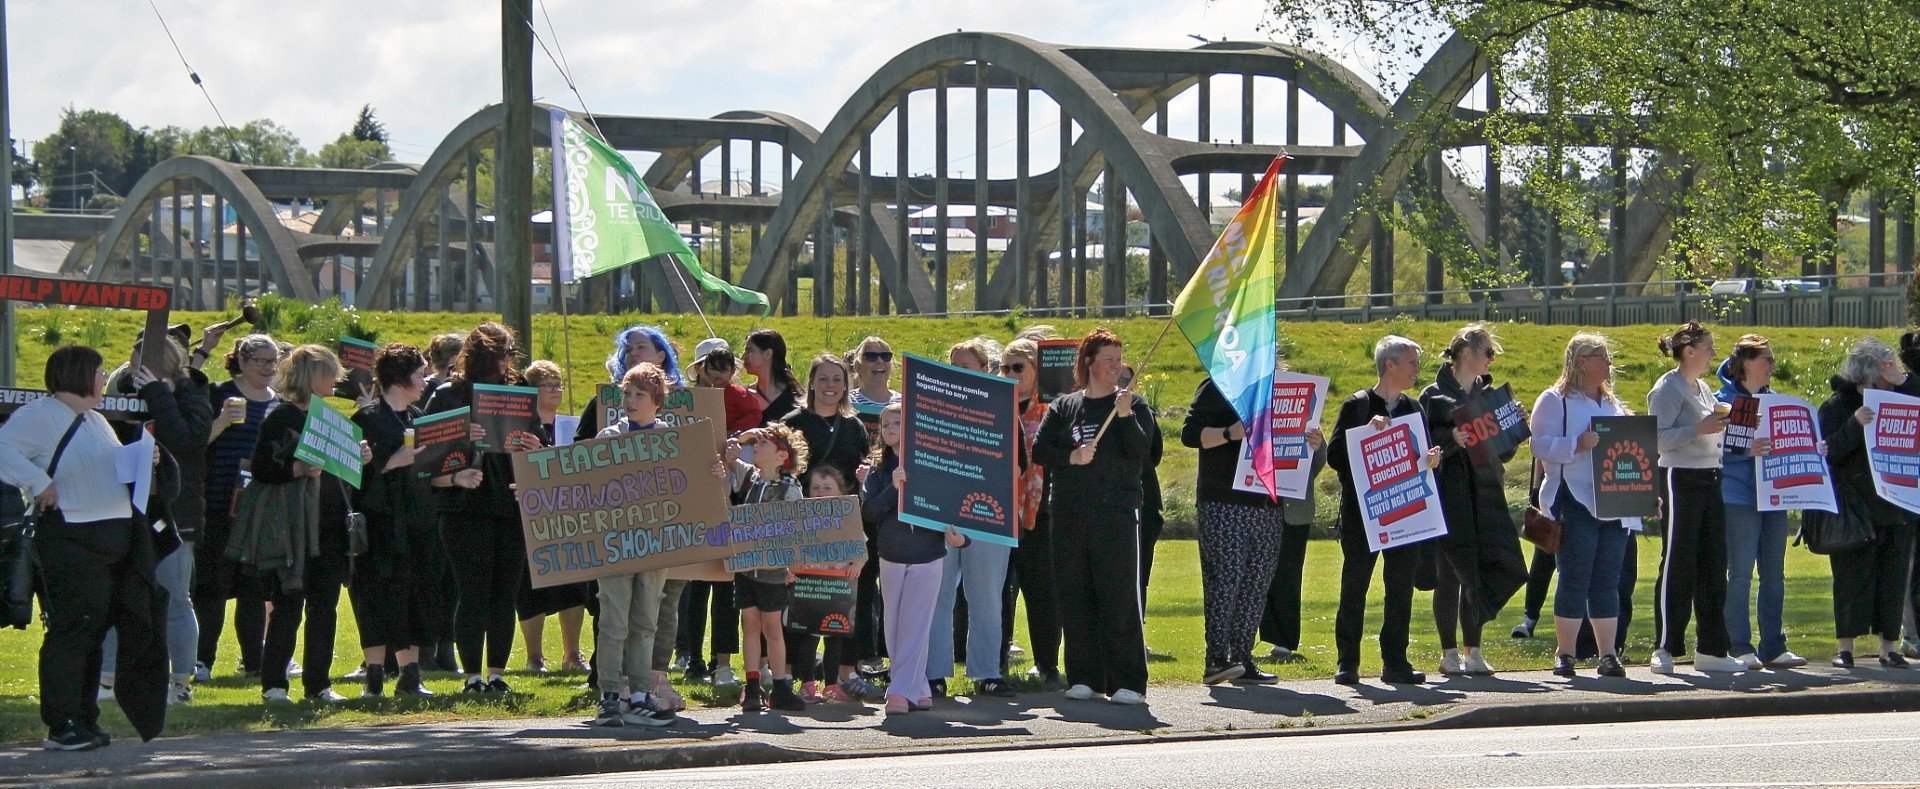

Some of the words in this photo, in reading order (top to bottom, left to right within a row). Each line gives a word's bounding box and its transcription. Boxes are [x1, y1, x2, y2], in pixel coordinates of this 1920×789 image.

[607, 203, 628, 218] TE
[61, 283, 167, 310] WANTED
[916, 373, 949, 387] Educators
[963, 386, 988, 398] coming
[916, 381, 944, 393] together
[1297, 387, 1309, 396] FOR
[1495, 403, 1511, 419] SAVE
[1773, 410, 1800, 418] STANDING
[1881, 408, 1908, 417] STANDING
[1908, 409, 1919, 418] FOR
[915, 421, 938, 431] ensure
[952, 430, 968, 439] work
[916, 412, 934, 423] Value
[935, 419, 969, 432] educators
[970, 427, 988, 437] fairly
[1272, 417, 1301, 429] UCATION
[1461, 411, 1499, 447] SOS
[1773, 419, 1811, 436] PUBLIC
[1879, 417, 1917, 435] PUBLIC
[1364, 434, 1392, 452] STANDING
[1392, 430, 1404, 441] FOR
[1774, 436, 1814, 450] EDUCATION
[1878, 436, 1915, 449] EDUCATION
[303, 431, 326, 452] VALUE
[326, 442, 340, 460] OUR
[340, 450, 361, 474] FUTURE
[528, 431, 680, 479] TEACHERS
[1366, 441, 1408, 470] PUBLIC
[915, 450, 939, 462] Defend
[940, 458, 964, 469] quality
[965, 463, 982, 473] early
[915, 459, 948, 472] childhood
[1617, 461, 1633, 470] kimi
[1806, 462, 1822, 473] KURA
[1902, 464, 1919, 476] KURA
[1372, 460, 1411, 484] EDUCATION
[1615, 470, 1640, 480] haeata
[522, 467, 687, 515] OVERWORKED
[1406, 485, 1426, 502] KURA
[1600, 483, 1618, 492] back
[1618, 484, 1630, 492] our
[1631, 483, 1653, 492] future
[758, 499, 854, 523] WHITEBOARD
[531, 500, 680, 541] UNDERPAID
[731, 520, 797, 544] ARKERS
[802, 516, 842, 531] LAST
[533, 541, 604, 576] STILL
[603, 520, 706, 565] SHOWING
[706, 522, 730, 547] UP
[755, 530, 819, 550] LONGER
[728, 550, 764, 571] THAN
[767, 547, 795, 566] OUR
[800, 540, 866, 564] FUNDING
[815, 586, 851, 594] childhood
[822, 580, 849, 588] quality
